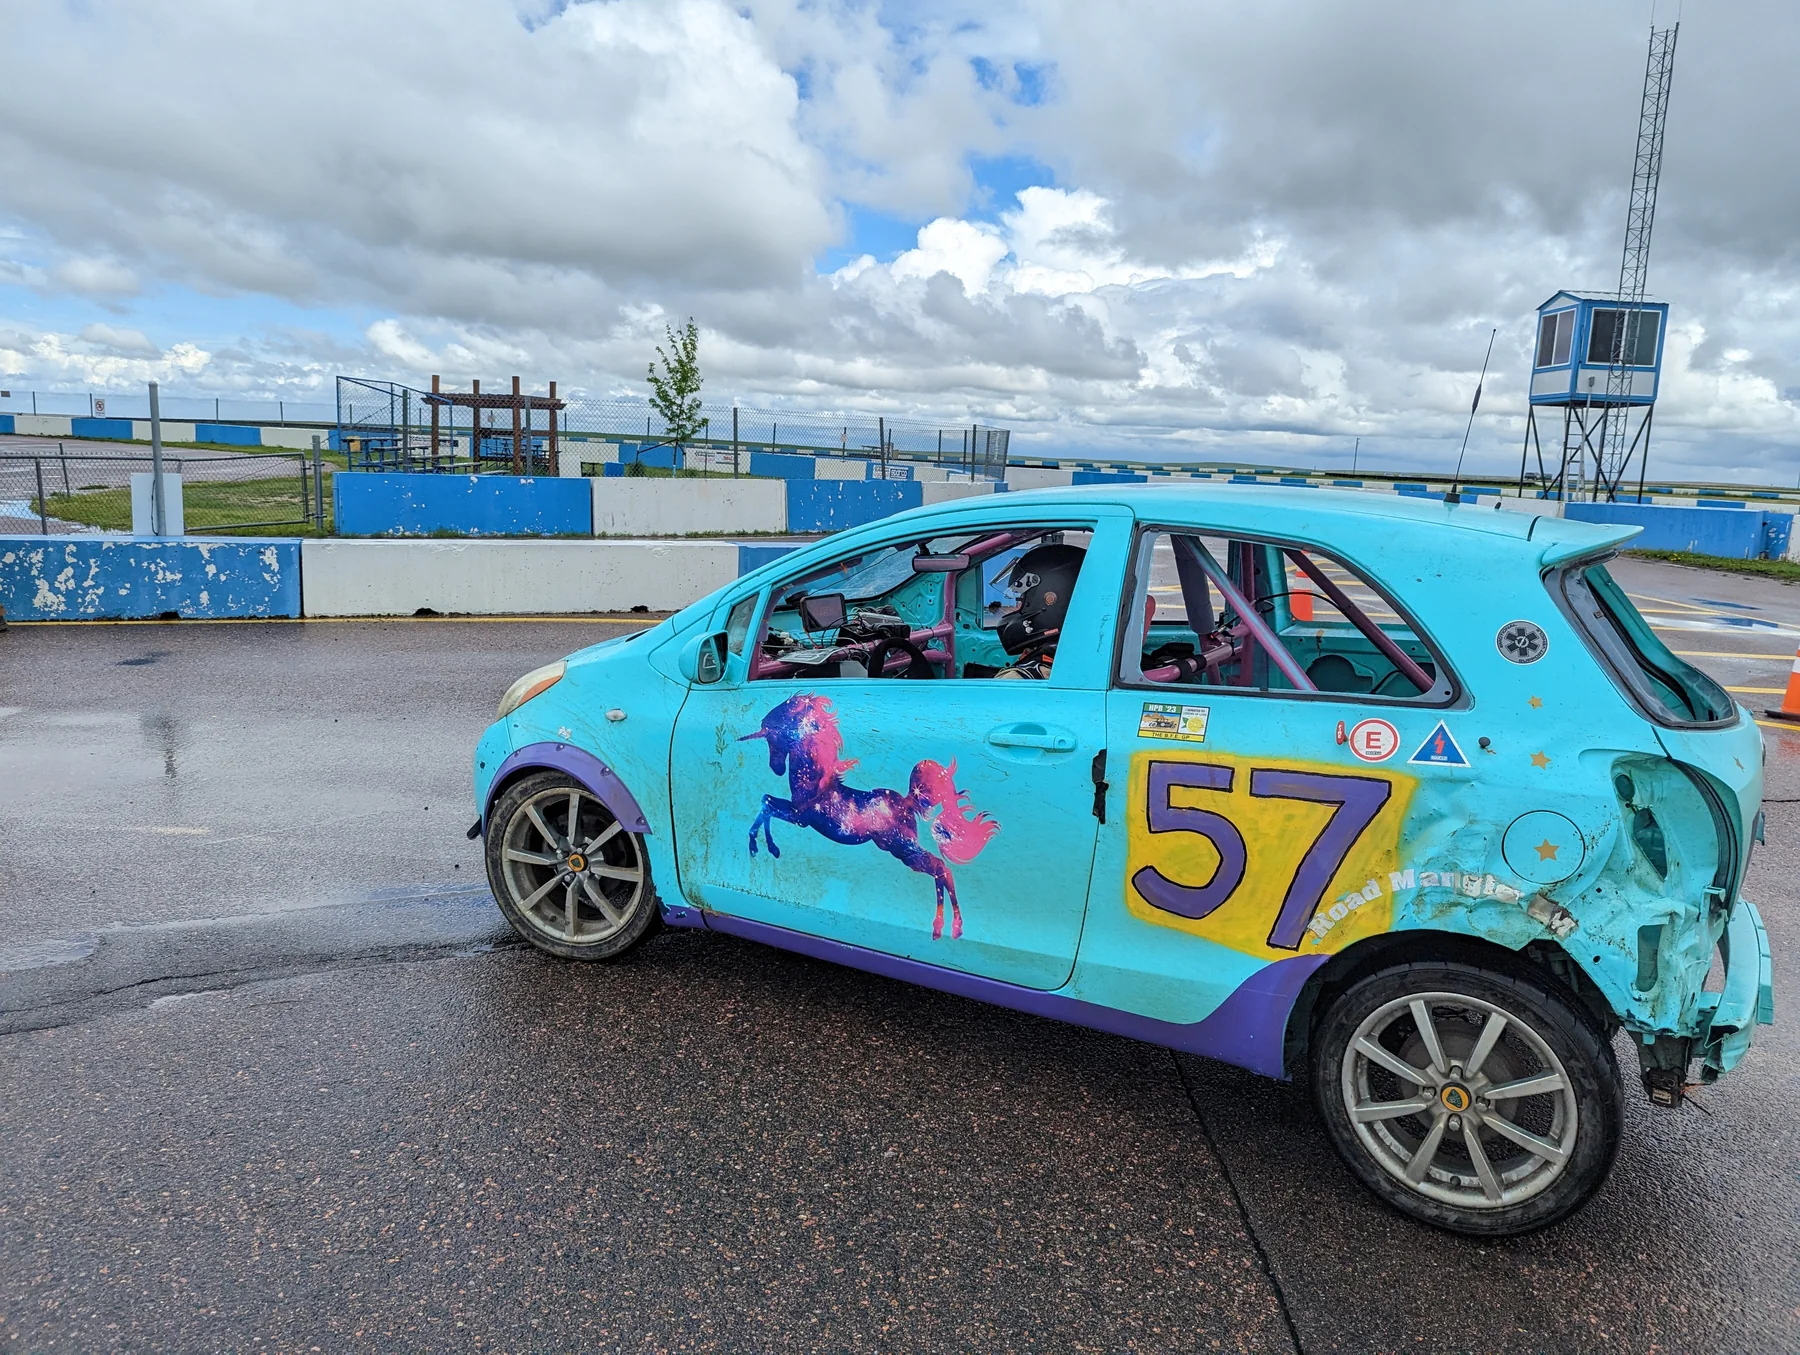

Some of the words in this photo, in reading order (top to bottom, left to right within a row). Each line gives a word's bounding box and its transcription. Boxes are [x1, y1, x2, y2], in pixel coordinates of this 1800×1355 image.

[1365, 731, 1382, 749] E
[1131, 760, 1392, 952] 57
[1307, 877, 1383, 939] Road
